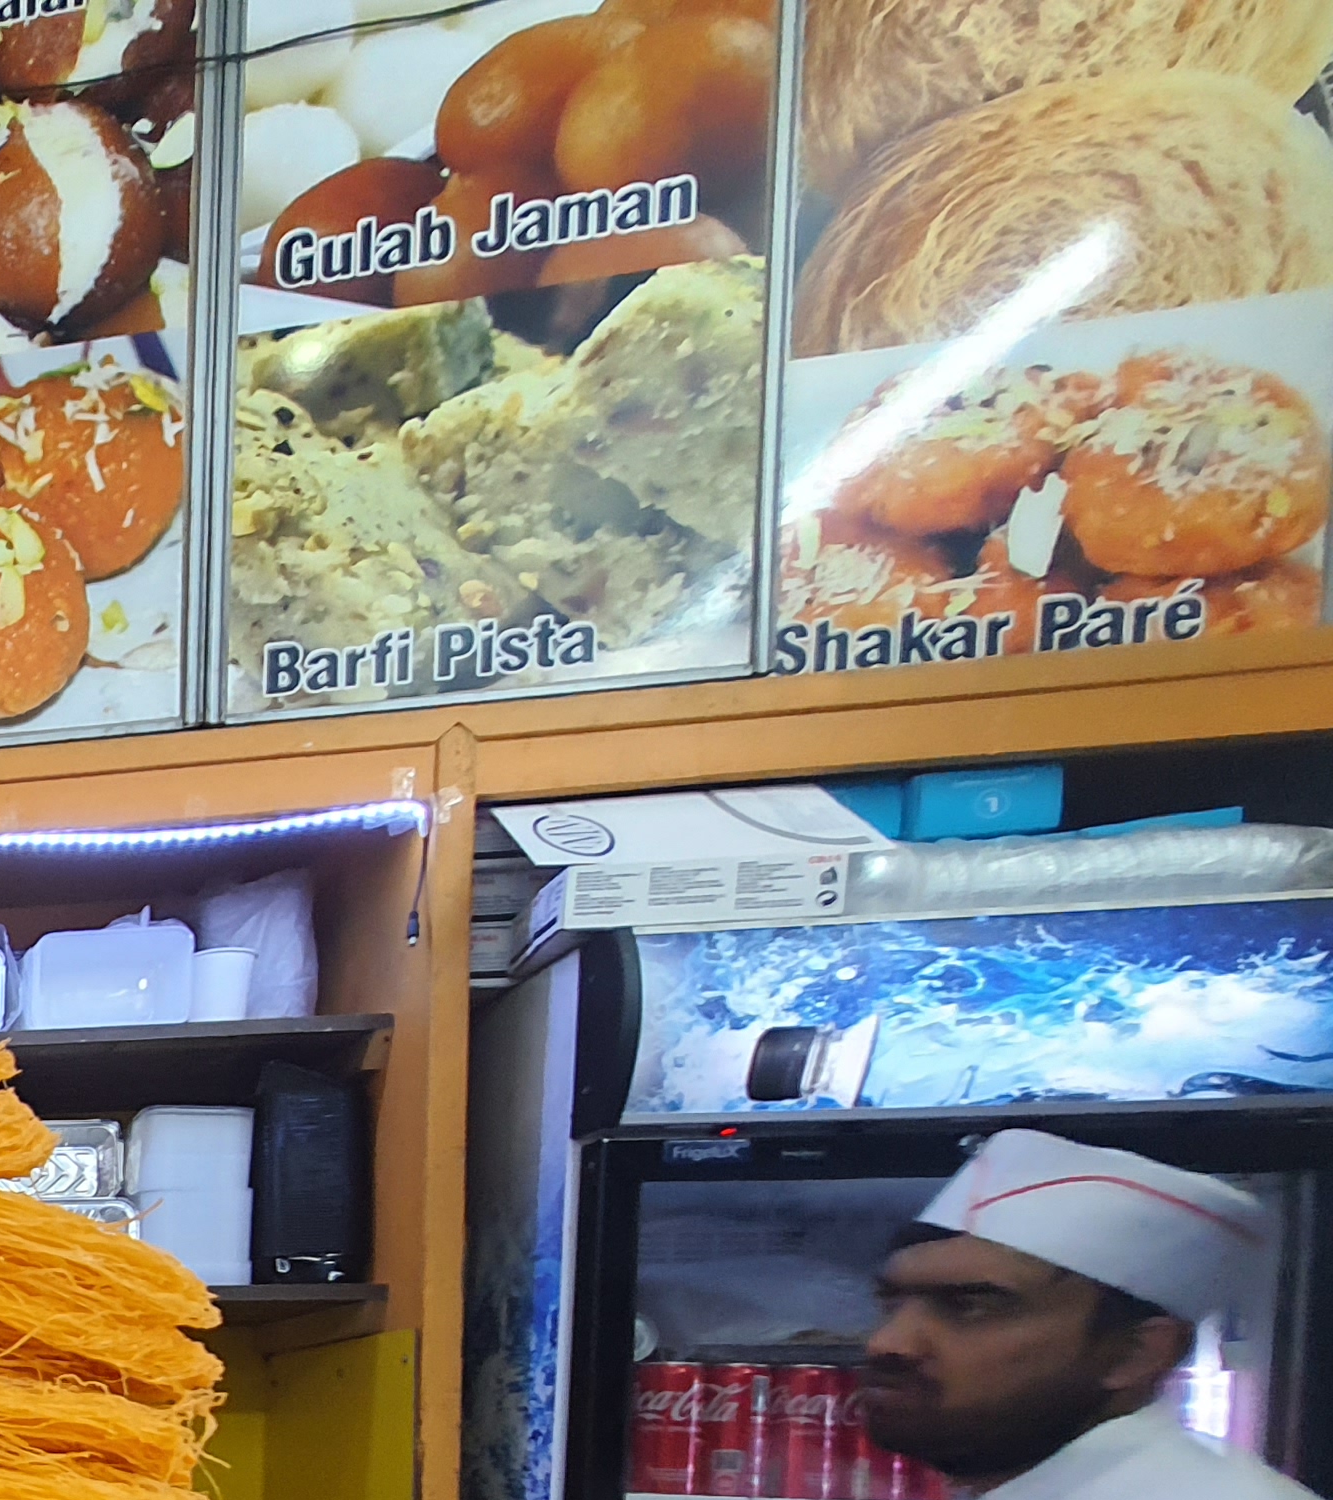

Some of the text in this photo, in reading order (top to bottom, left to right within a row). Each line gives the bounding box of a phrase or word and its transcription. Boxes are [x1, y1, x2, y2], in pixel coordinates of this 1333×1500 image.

[277, 176, 696, 287] Gulab Jaman
[264, 615, 597, 696] Barfi Pista
[774, 578, 1204, 676] Shakar Paré
